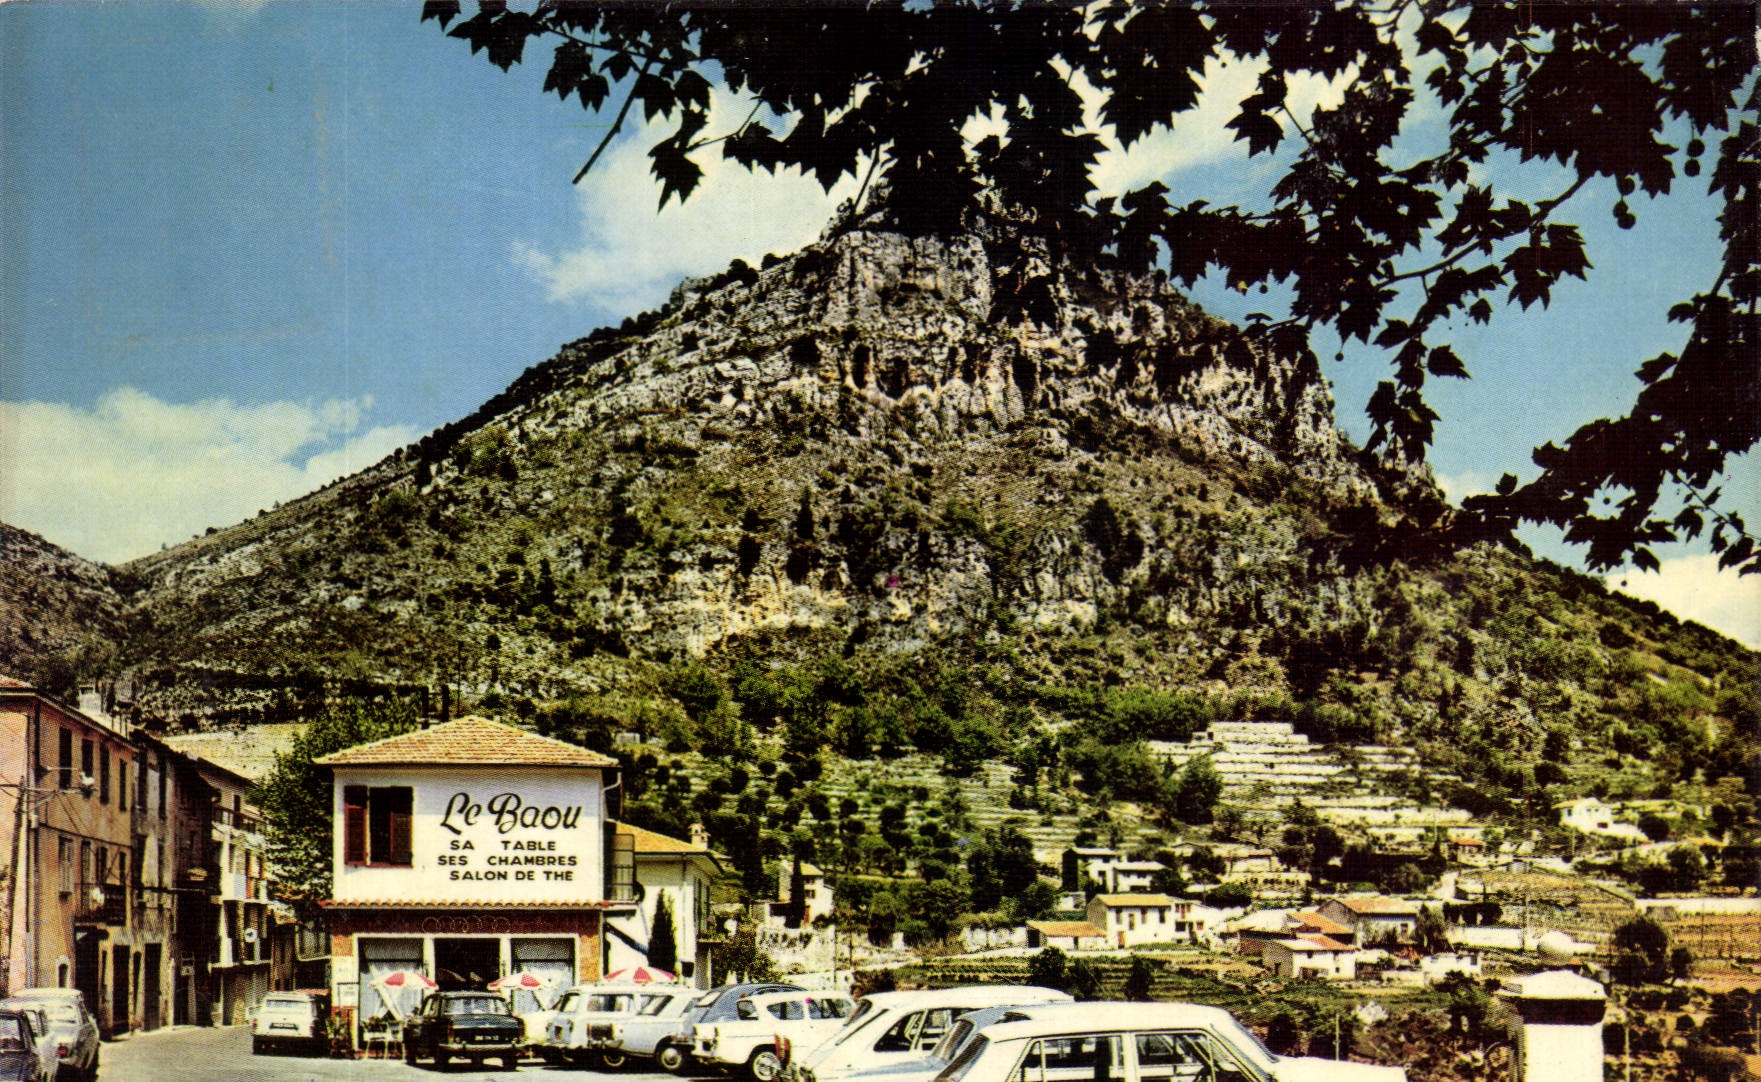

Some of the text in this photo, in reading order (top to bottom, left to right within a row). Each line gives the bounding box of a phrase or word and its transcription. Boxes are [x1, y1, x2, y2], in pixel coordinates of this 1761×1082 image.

[440, 791, 582, 836] Le Baou
[450, 839, 556, 851] SA TABLE
[437, 855, 577, 866] SES CHAMBRES
[449, 870, 573, 881] SALON DE THE
